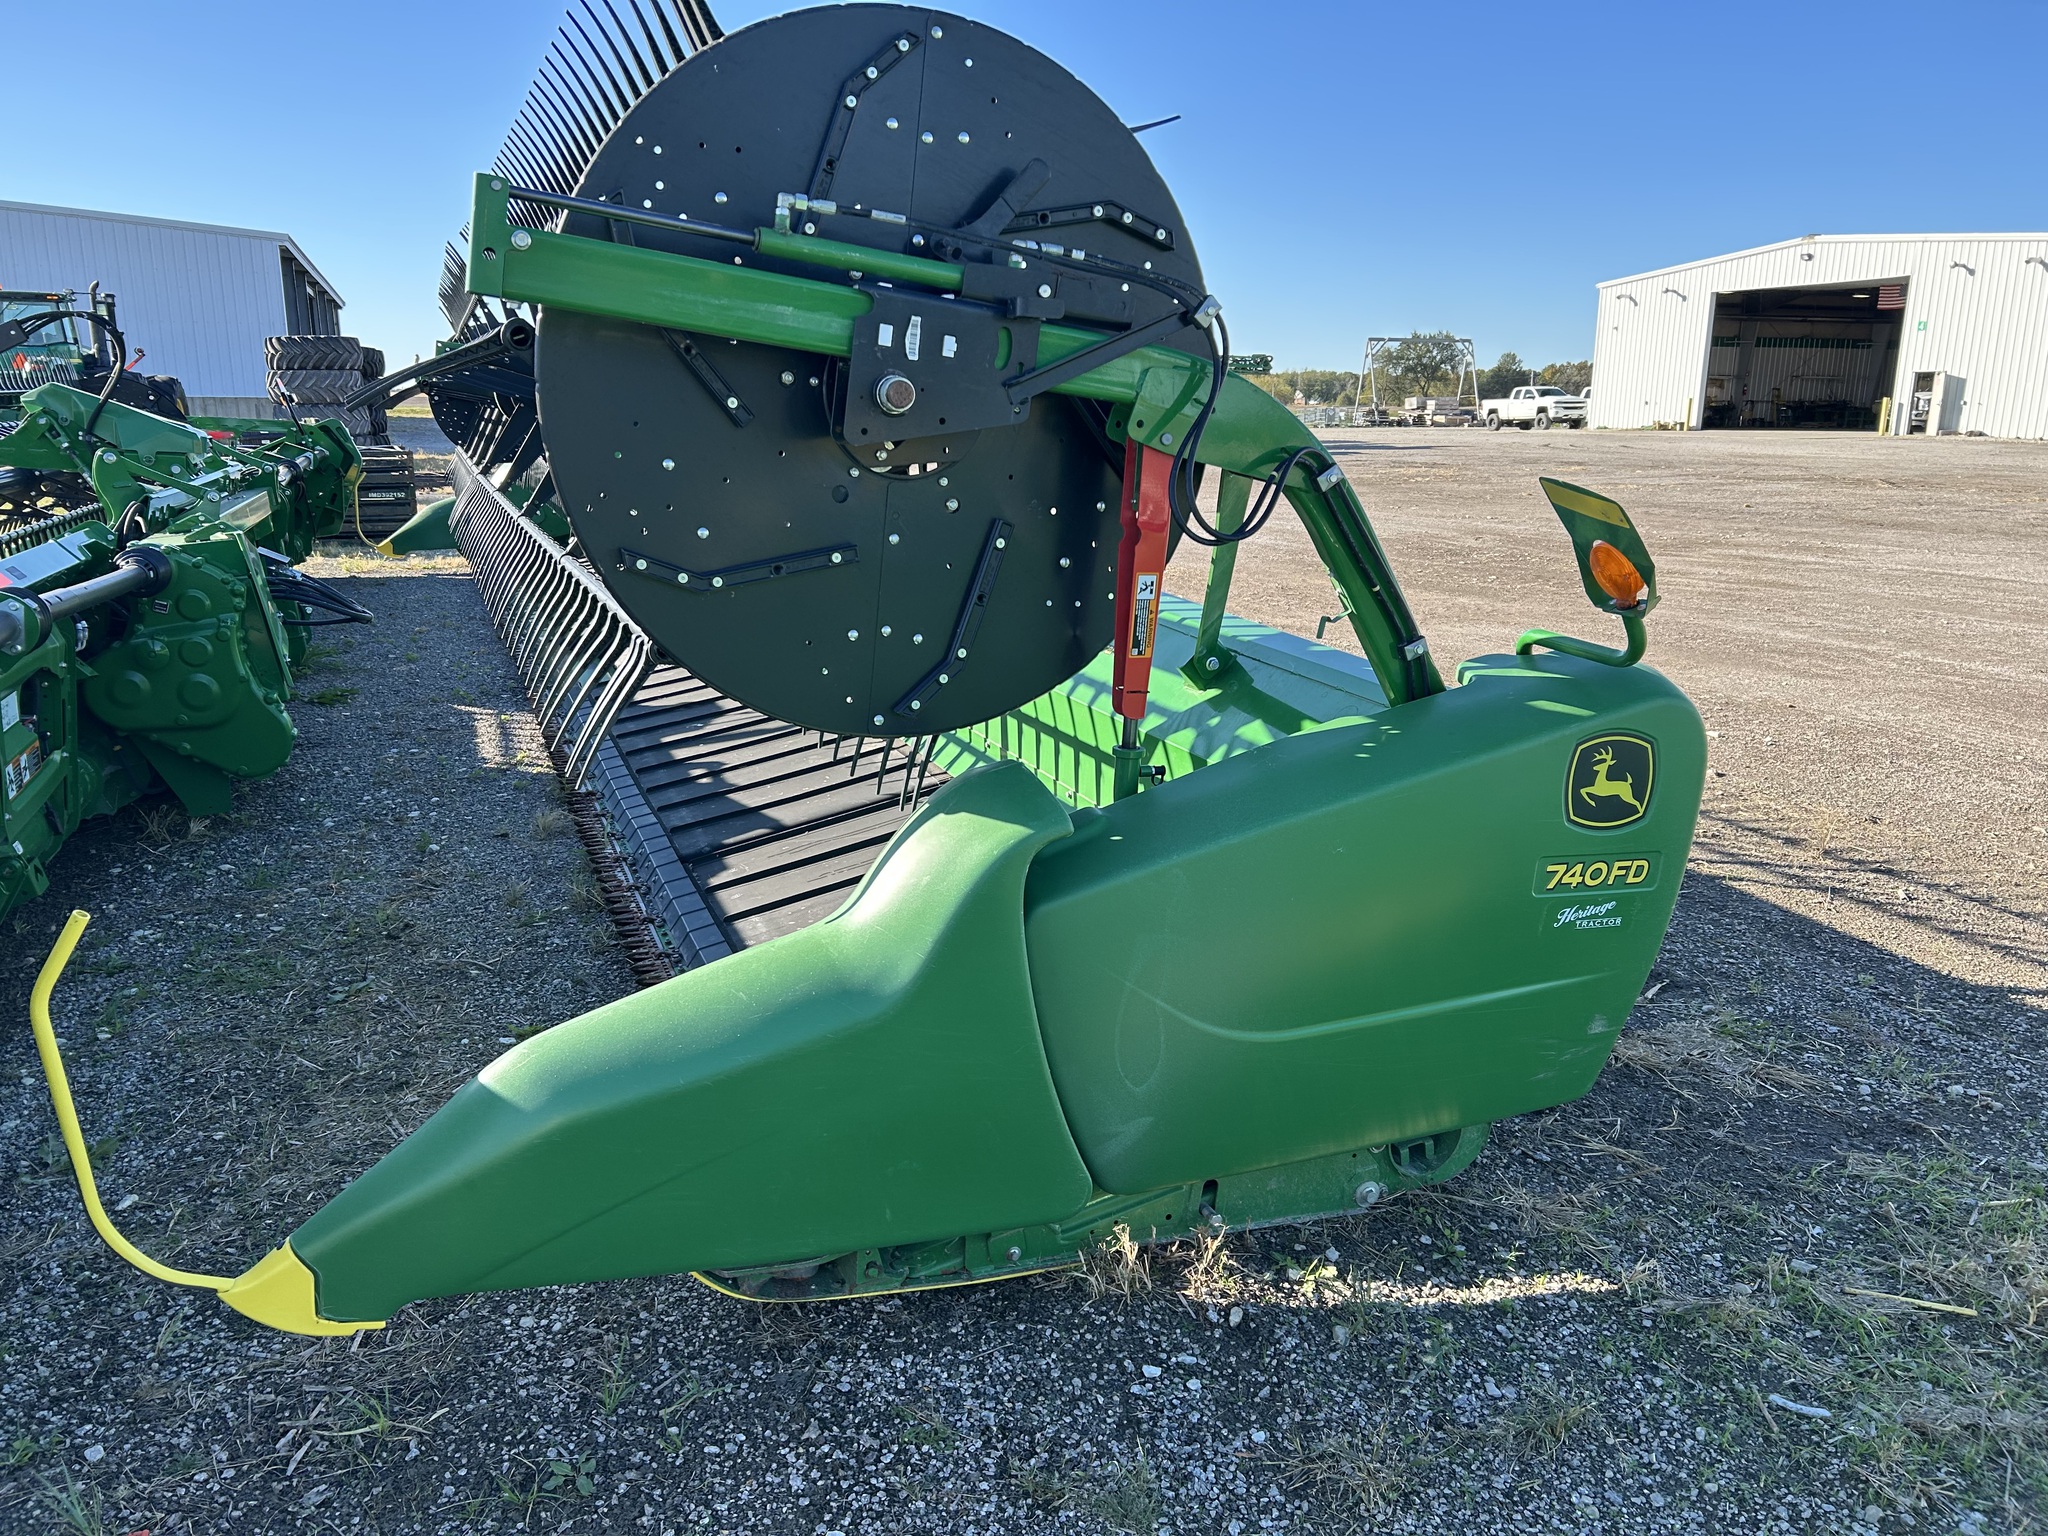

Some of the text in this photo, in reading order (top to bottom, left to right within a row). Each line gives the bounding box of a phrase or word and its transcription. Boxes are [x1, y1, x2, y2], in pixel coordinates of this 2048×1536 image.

[1146, 617, 1155, 649] WARNING
[1545, 858, 1650, 891] 740FD
[1553, 900, 1618, 928] Heritage
[1575, 918, 1622, 929] TRACTOR
